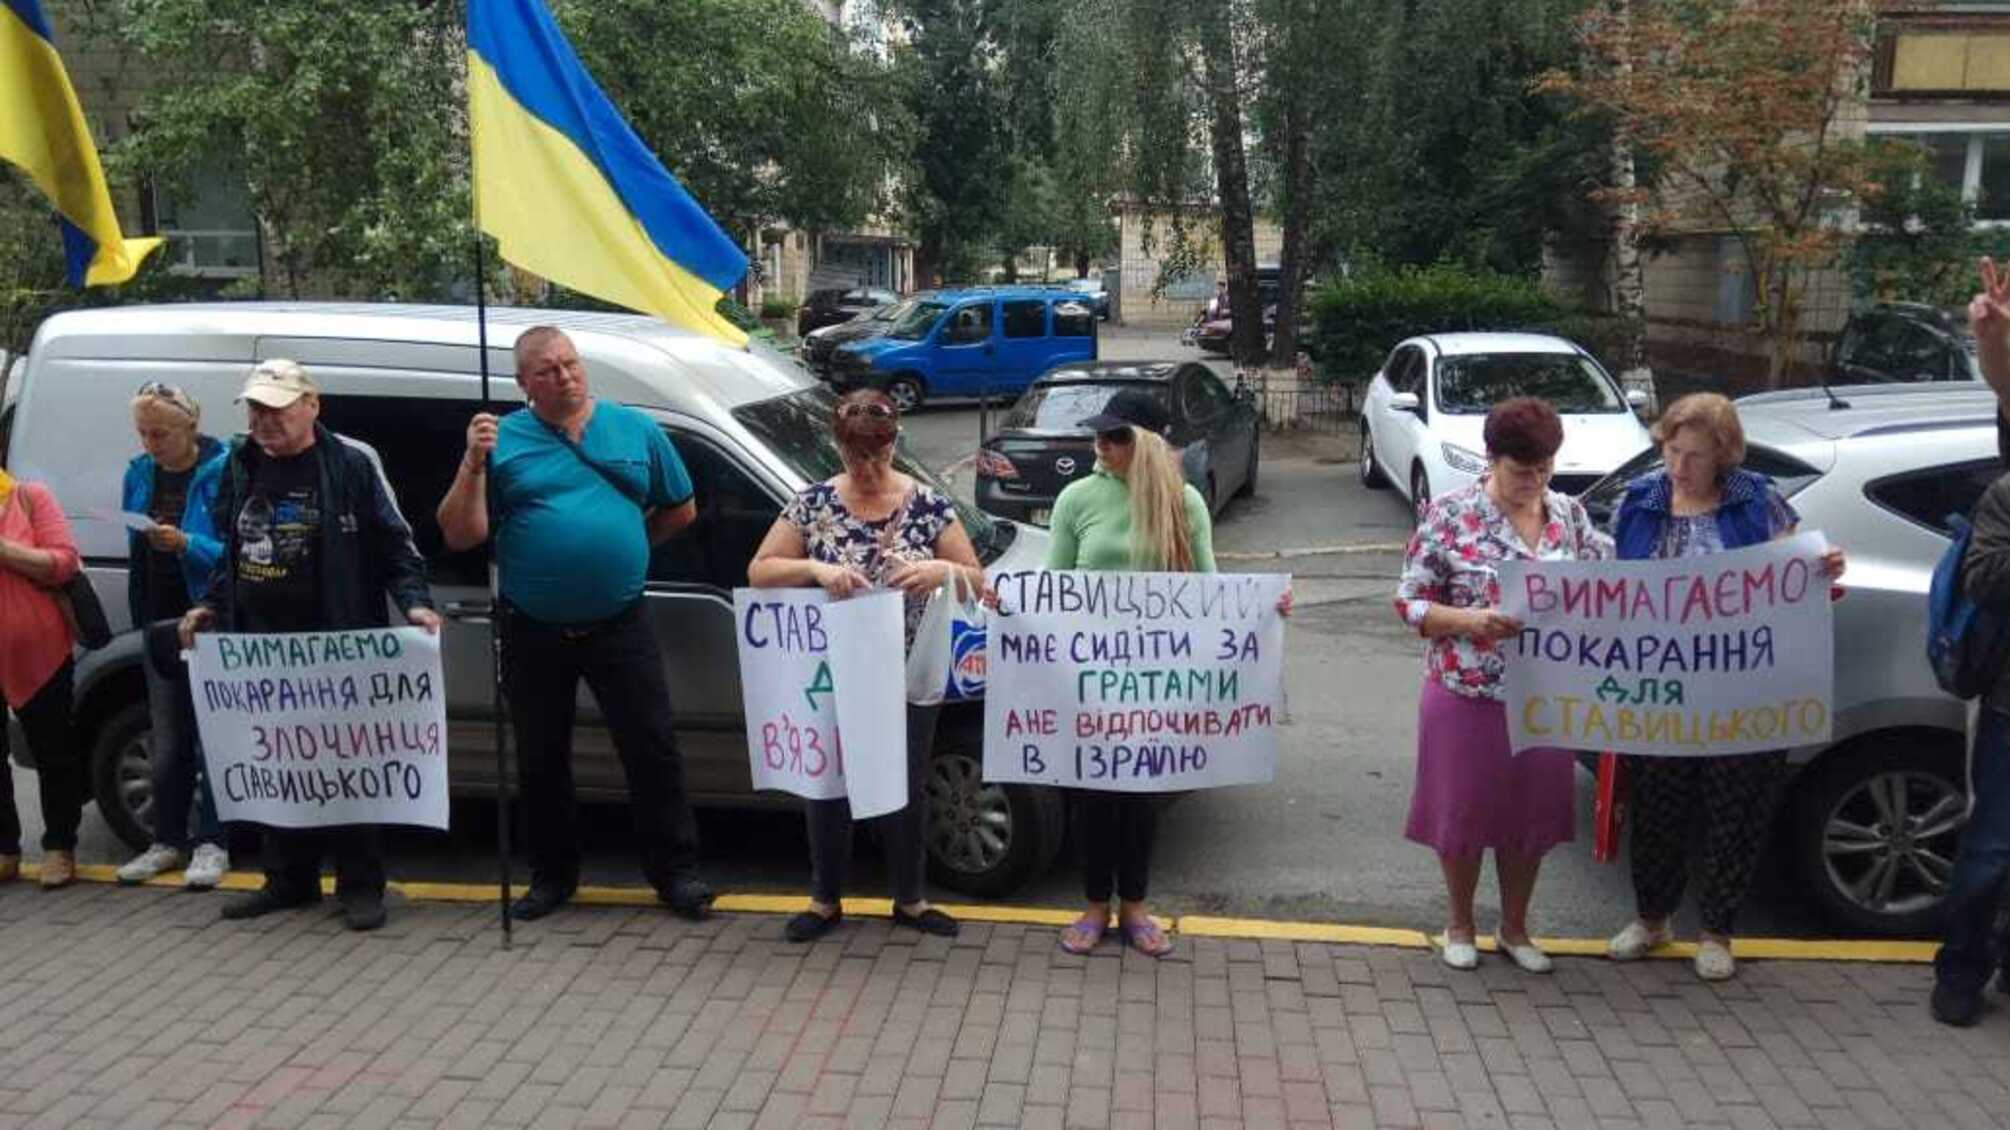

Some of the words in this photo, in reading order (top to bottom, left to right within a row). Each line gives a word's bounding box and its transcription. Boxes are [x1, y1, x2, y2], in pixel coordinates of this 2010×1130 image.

[993, 571, 1264, 621] СТАВИЦЬКИЙ
[1525, 557, 1809, 625] ВИМАГАЄМО
[218, 632, 401, 671] ВИМАГАЄМО
[1216, 628, 1260, 661] ЗА
[1518, 625, 1775, 674] ПОКАРАННЯ
[204, 675, 359, 713] ПОКАРАННЯ
[369, 672, 432, 708] ДЛЯ
[1078, 670, 1239, 704] ГРАТАМИ
[1596, 675, 1684, 705] ДЛЯ
[1522, 695, 1826, 745] СТАВИЦЬКОГО
[251, 722, 440, 763] ЗЛОЧИНЦЯ
[224, 760, 422, 807] СТАВИЦЬКОГО
